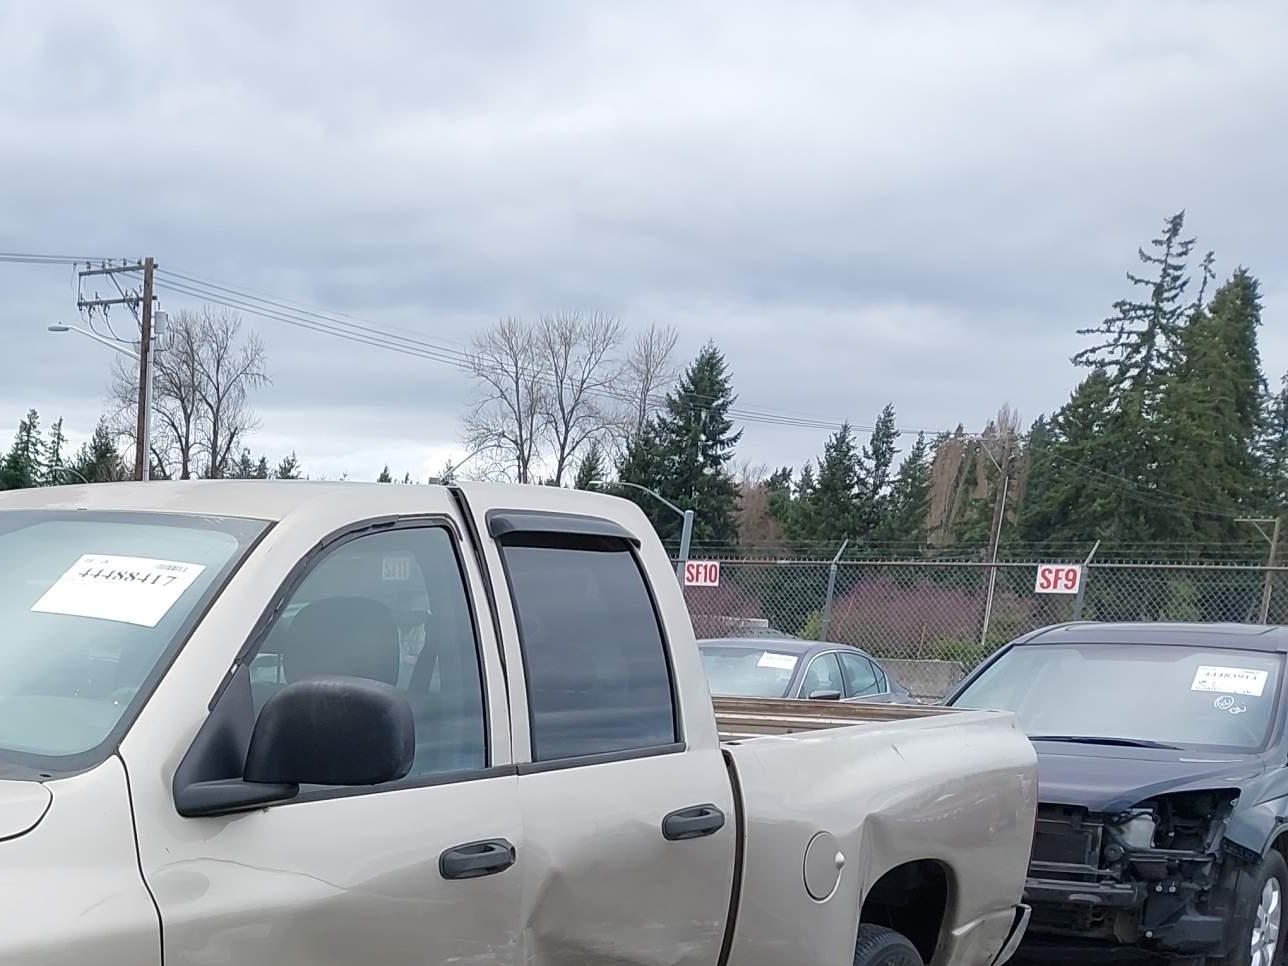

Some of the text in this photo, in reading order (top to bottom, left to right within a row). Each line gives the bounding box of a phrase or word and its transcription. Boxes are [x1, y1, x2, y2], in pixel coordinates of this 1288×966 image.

[78, 567, 177, 587] 44488417
[686, 563, 718, 583] SF10
[1039, 568, 1078, 590] SF9
